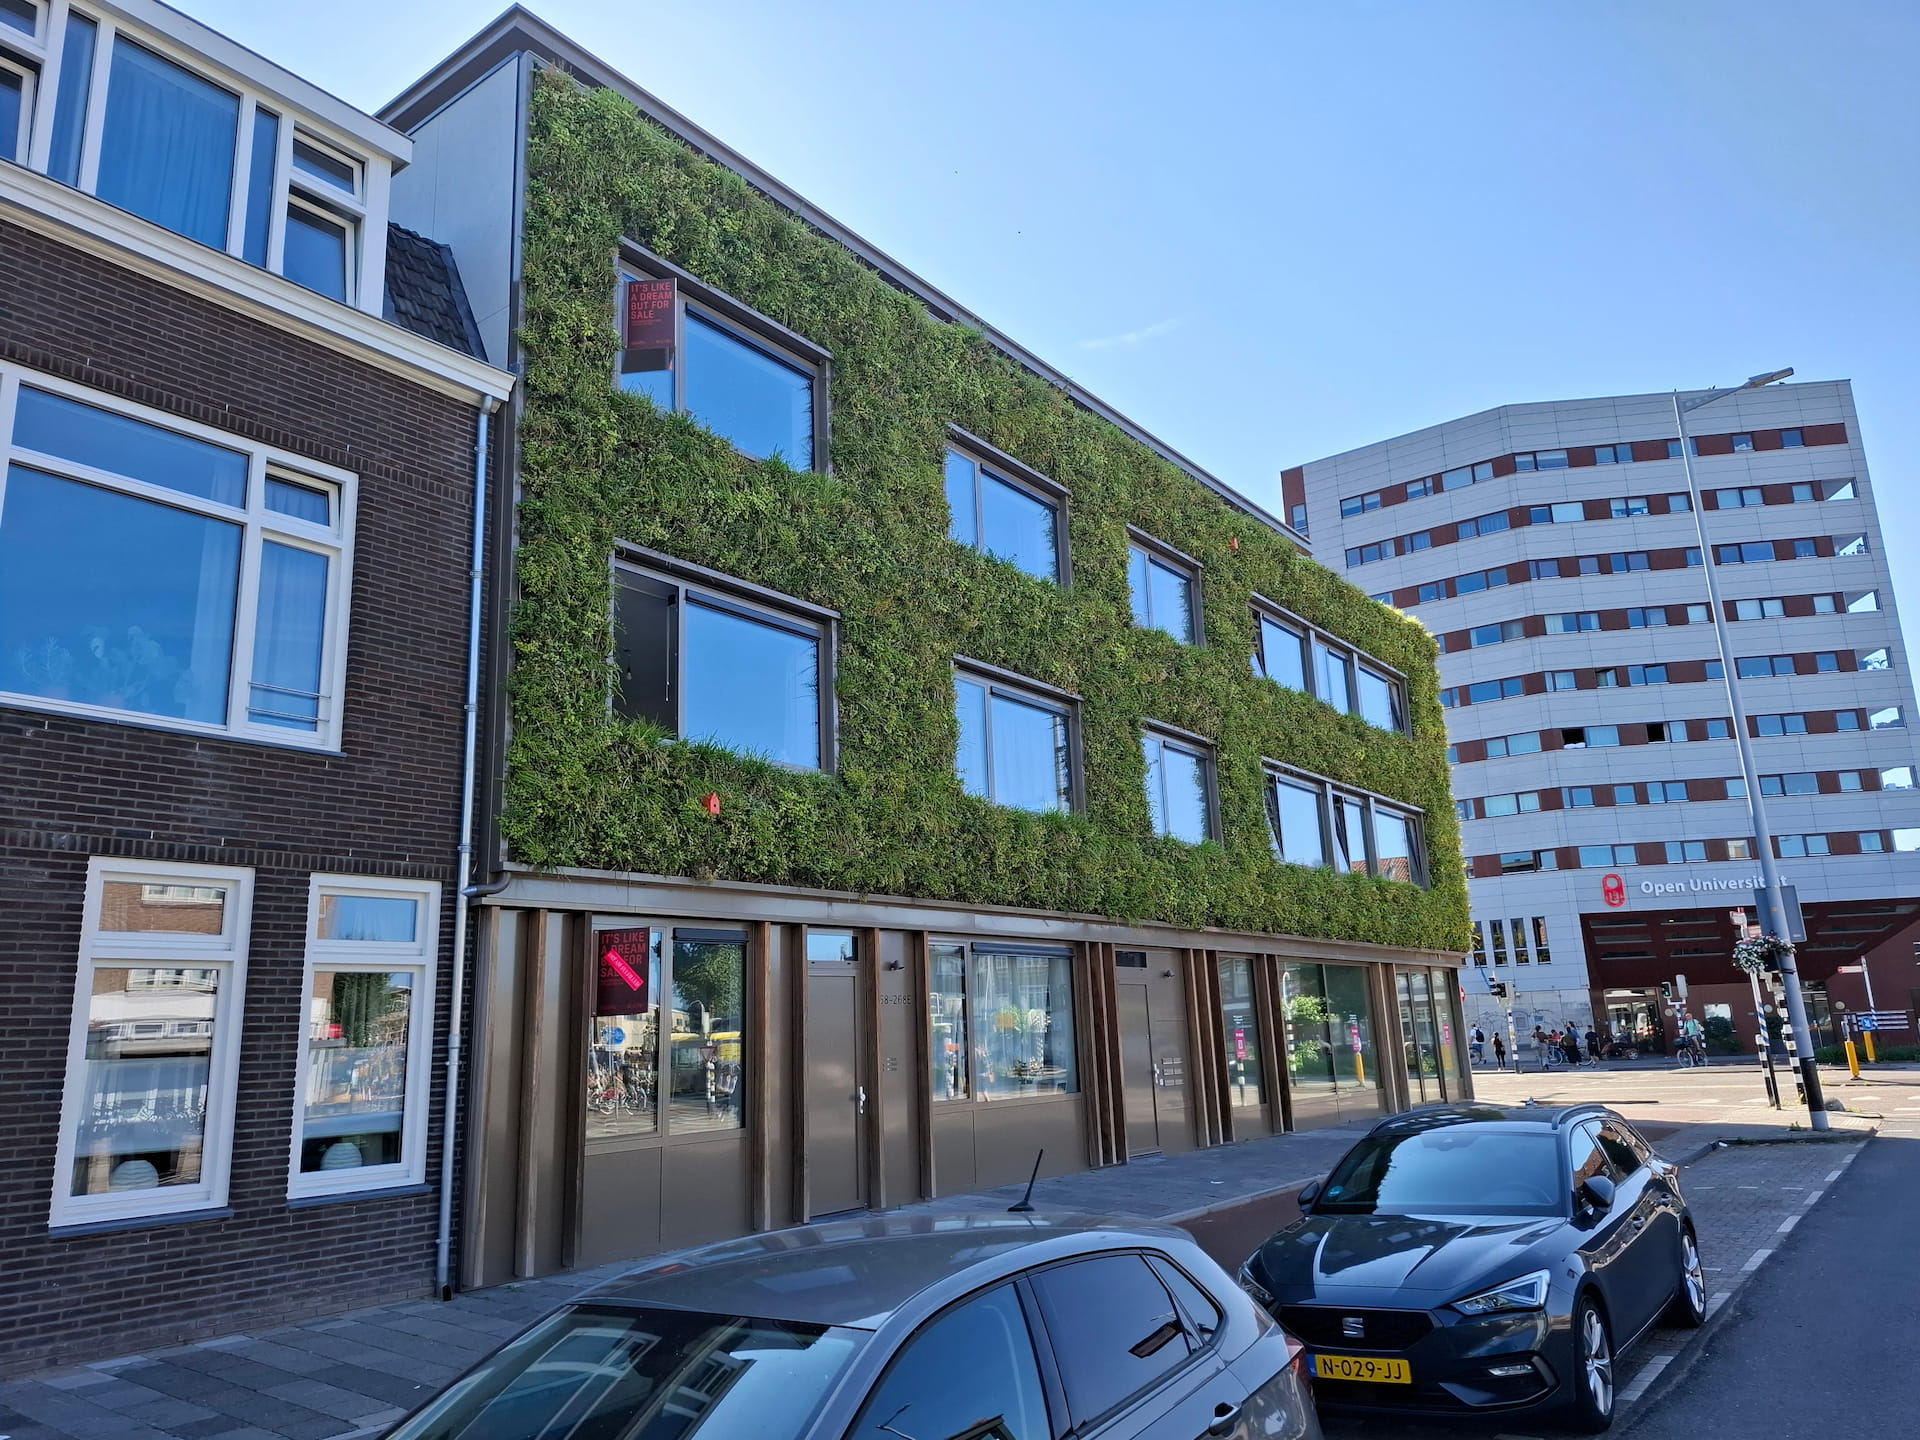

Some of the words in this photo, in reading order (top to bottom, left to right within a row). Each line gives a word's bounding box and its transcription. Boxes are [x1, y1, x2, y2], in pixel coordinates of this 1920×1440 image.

[631, 283, 648, 293] IT'S
[651, 281, 671, 292] LIKE
[631, 293, 637, 301] A
[640, 291, 672, 301] DREAM
[631, 301, 649, 310] BUT
[652, 300, 670, 309] FOR
[631, 310, 654, 320] SALE
[1640, 880, 1686, 897] Open
[601, 933, 620, 944] IT'S
[623, 931, 645, 943] LIKE
[601, 945, 607, 955] A
[1322, 1357, 1402, 1380] N-029-JJ
